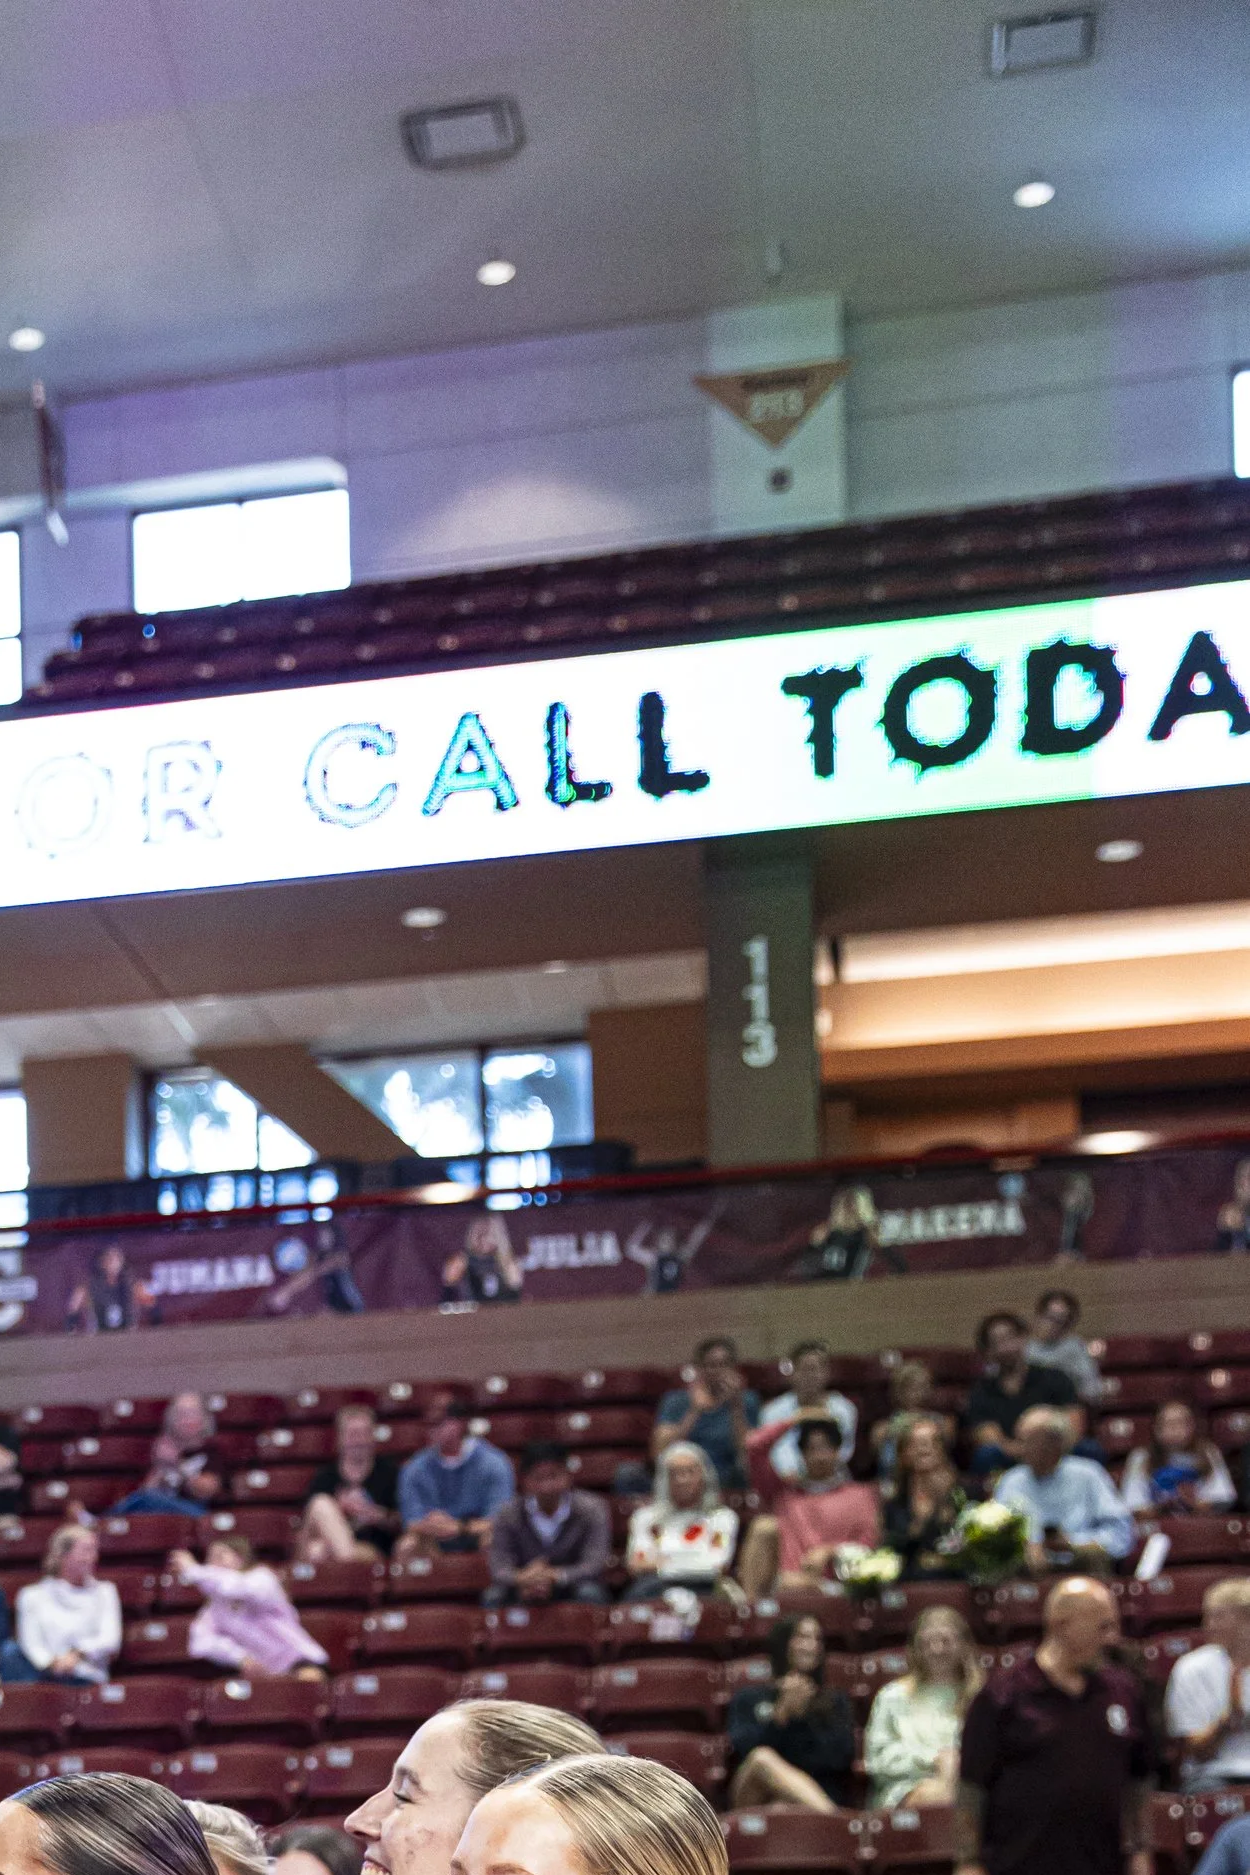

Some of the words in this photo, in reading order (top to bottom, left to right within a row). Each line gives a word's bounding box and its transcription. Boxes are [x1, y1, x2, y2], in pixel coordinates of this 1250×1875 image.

[16, 738, 224, 860] OR
[302, 688, 711, 829] CALL
[742, 934, 778, 1068] 113
